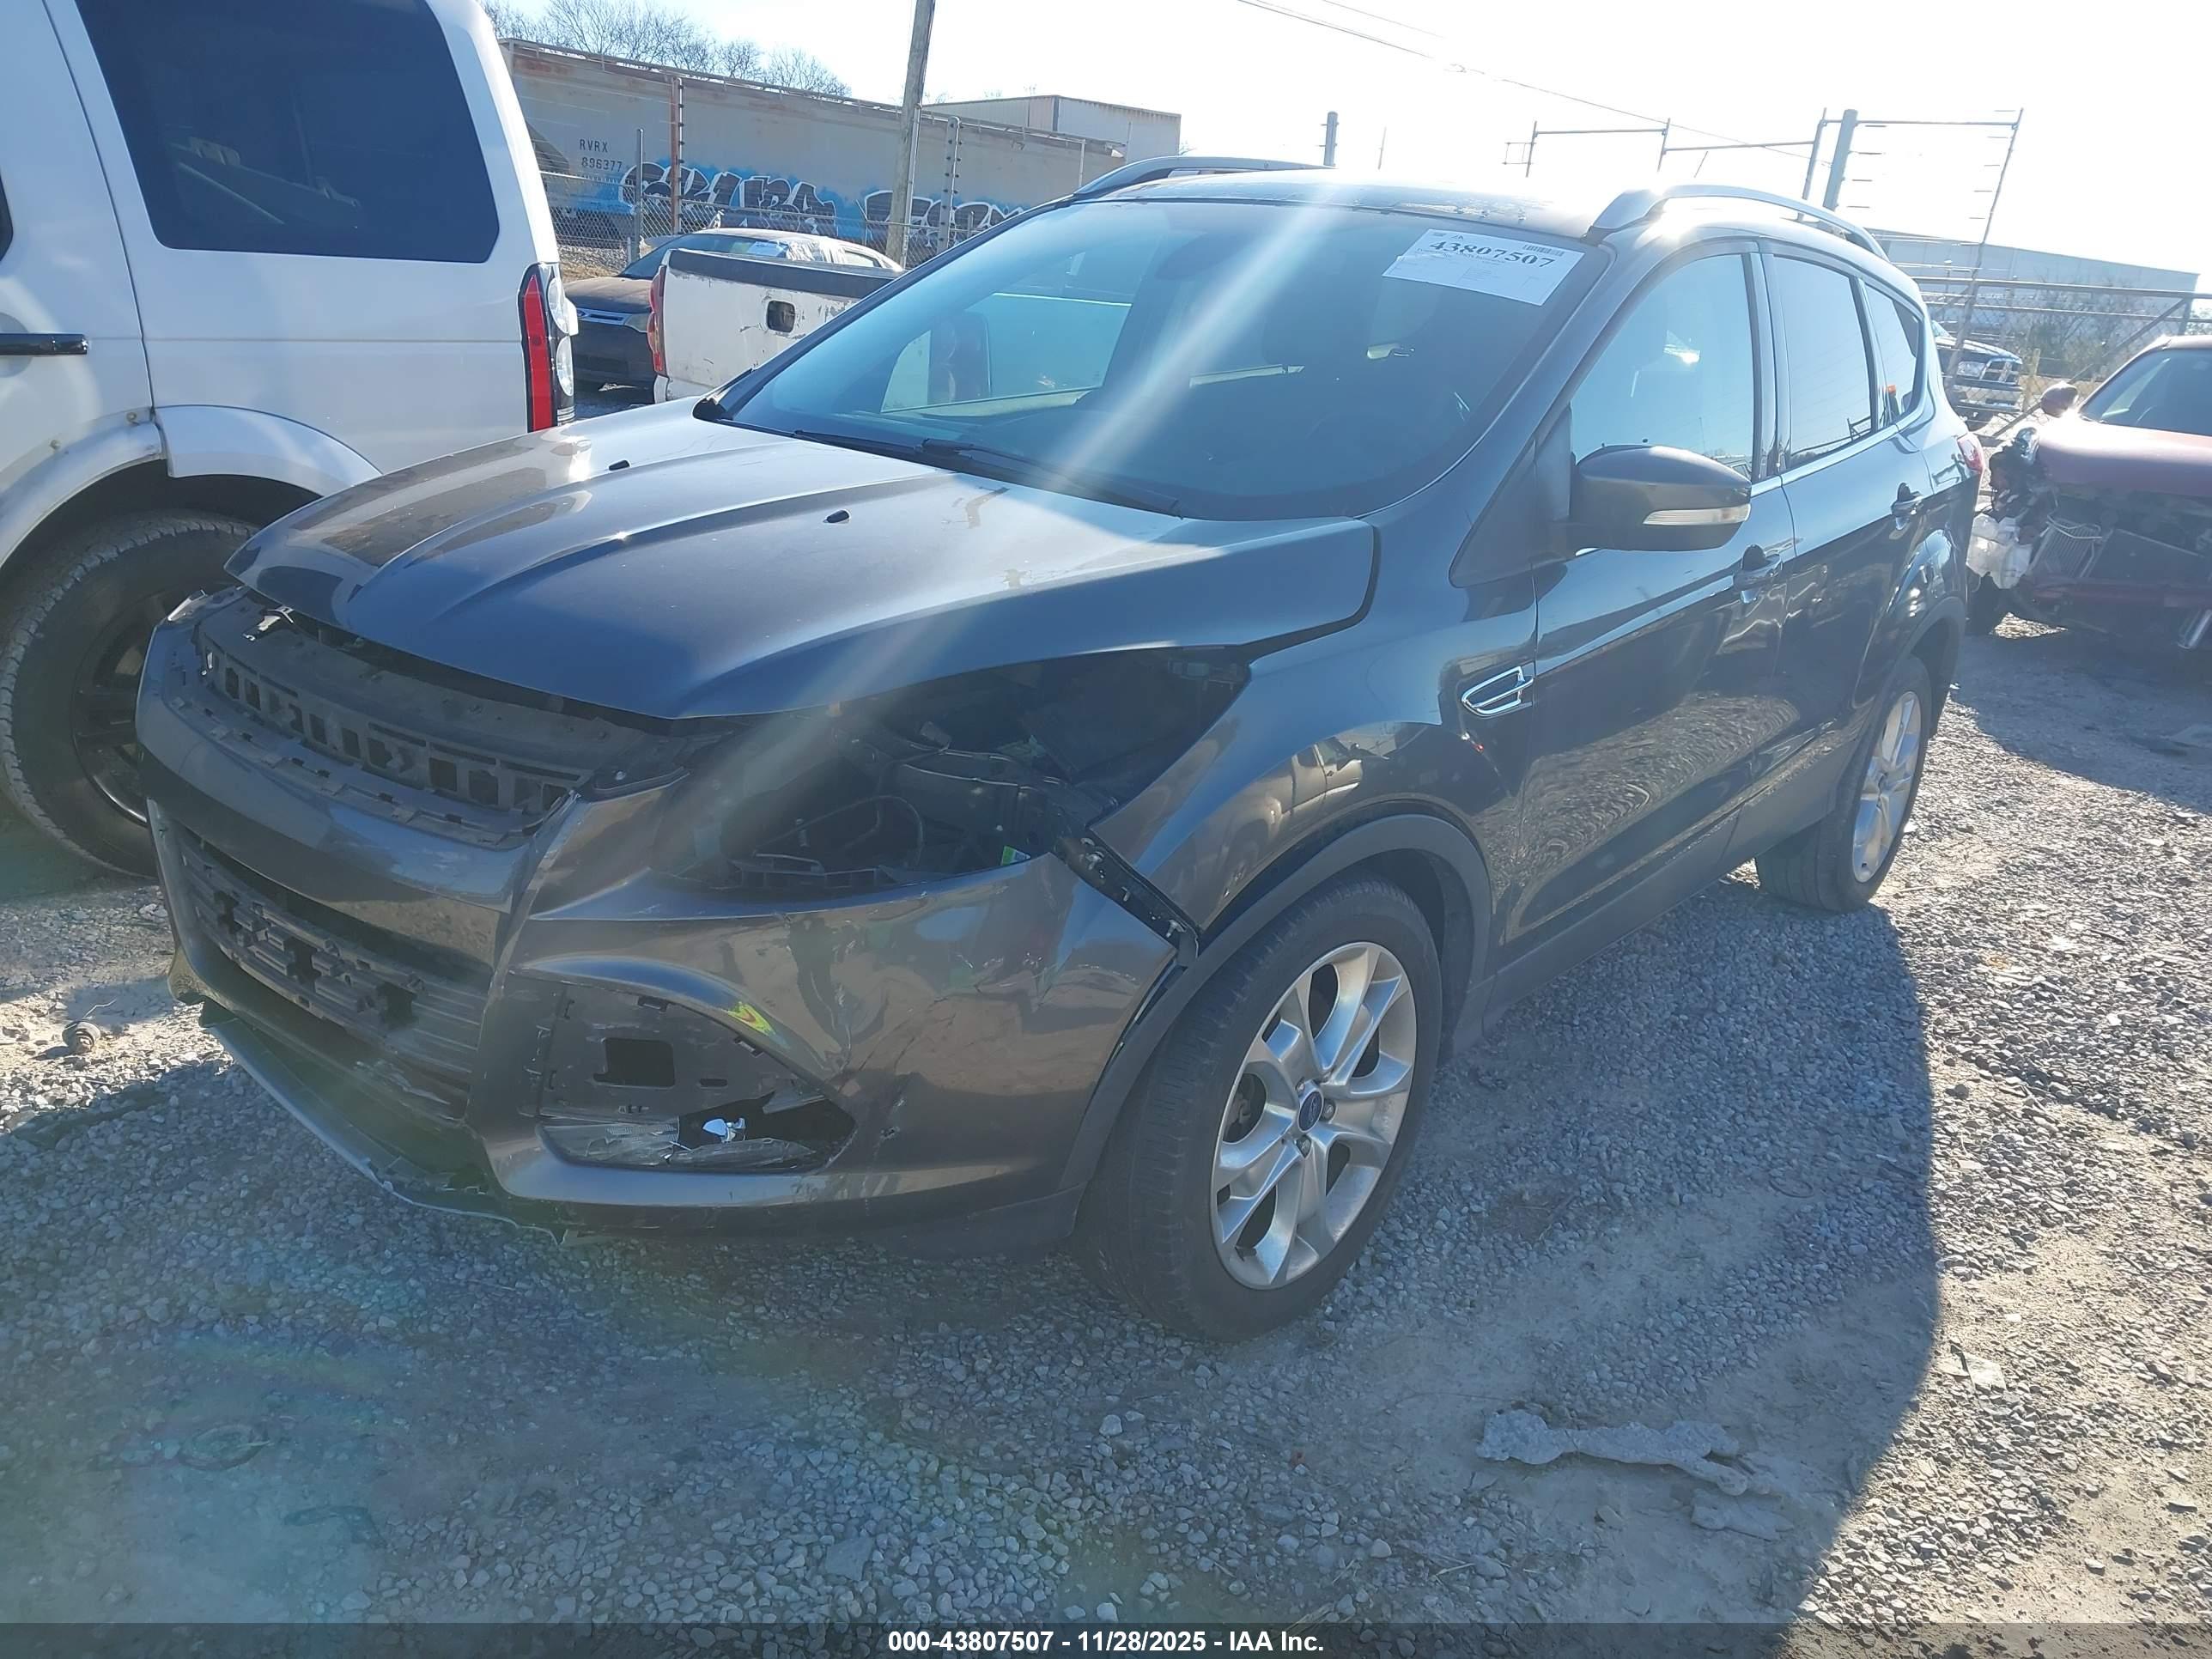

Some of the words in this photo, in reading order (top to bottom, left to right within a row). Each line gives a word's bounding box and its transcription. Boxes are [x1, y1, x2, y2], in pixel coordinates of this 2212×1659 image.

[580, 138, 608, 153] RVRX
[581, 156, 623, 172] 896377
[1429, 240, 1556, 268] 43807507
